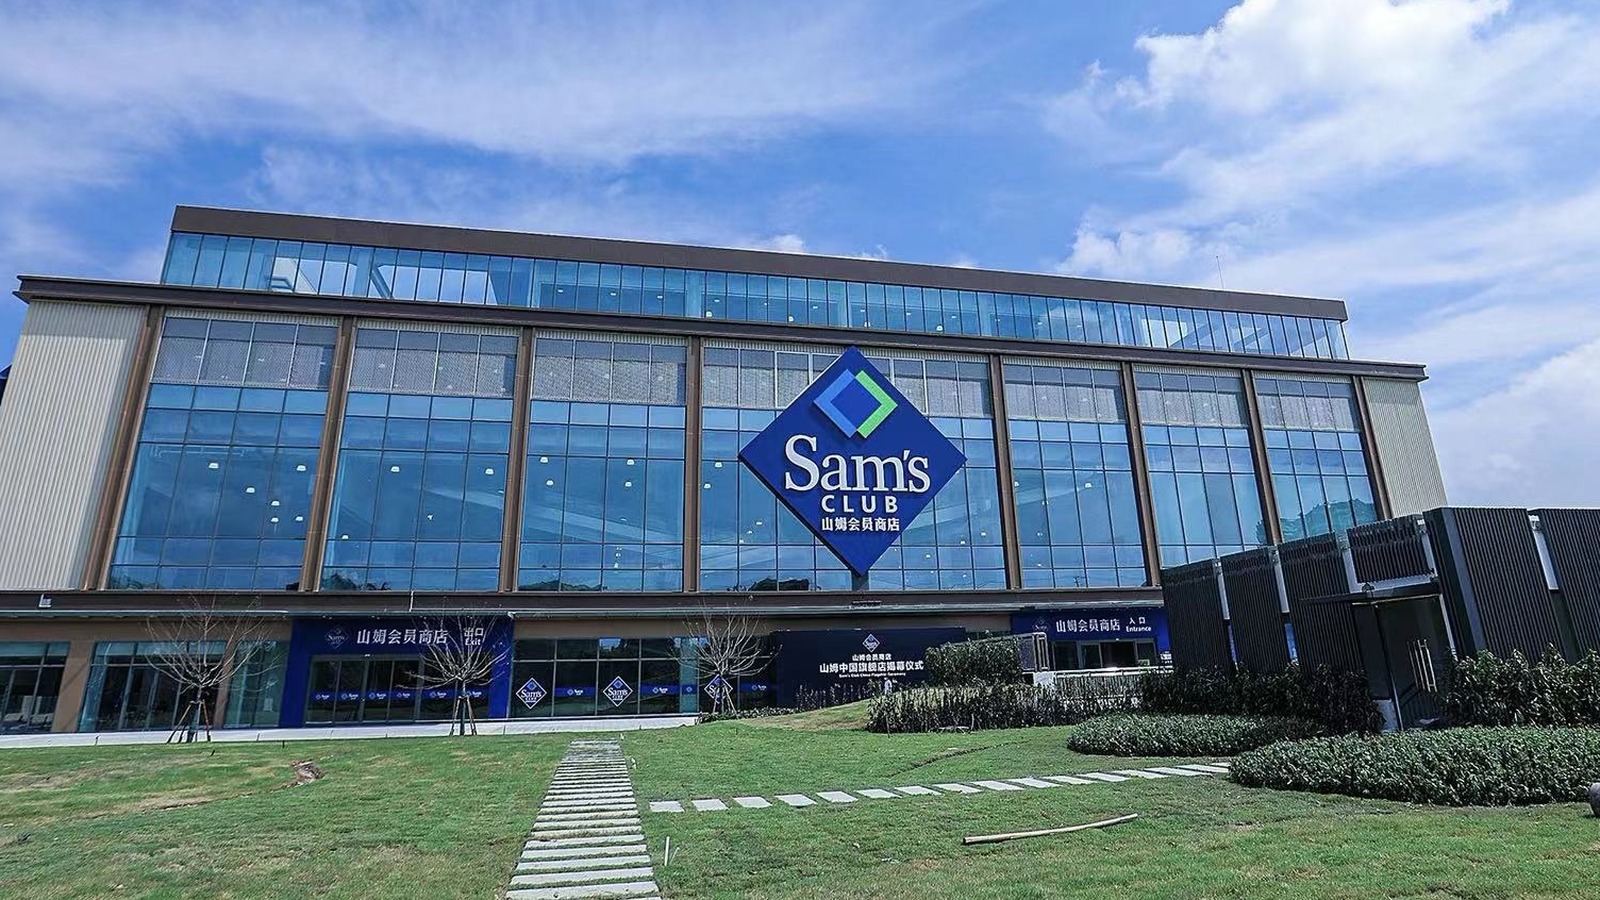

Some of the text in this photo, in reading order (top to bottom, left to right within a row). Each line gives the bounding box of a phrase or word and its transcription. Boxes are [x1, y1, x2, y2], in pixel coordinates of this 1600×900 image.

[785, 434, 931, 493] Sam's
[821, 495, 899, 513] CLUB
[821, 516, 900, 532] 山姆会员商店
[1055, 618, 1121, 633] 山姆会员商店
[1129, 616, 1146, 625] 入口
[463, 627, 484, 637] 出口
[1125, 625, 1152, 633] Entrance
[356, 628, 449, 645] 山姆会员商店
[464, 637, 481, 646] Exit
[819, 660, 924, 673] 山姆中国旗舰店揭幕仪式
